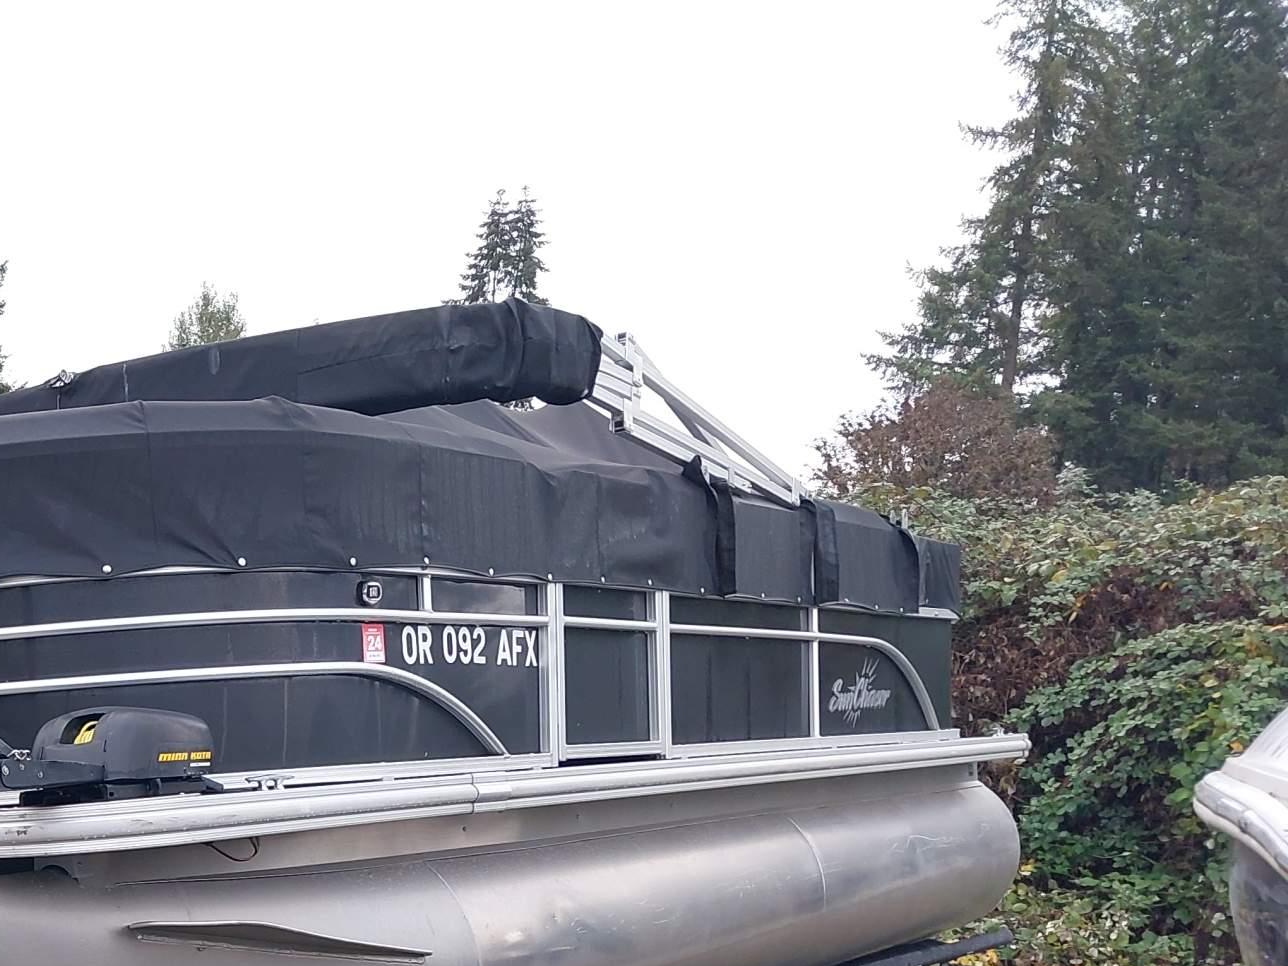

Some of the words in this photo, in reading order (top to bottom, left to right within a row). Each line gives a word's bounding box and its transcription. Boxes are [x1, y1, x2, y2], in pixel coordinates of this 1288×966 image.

[366, 635, 383, 652] 24
[401, 625, 434, 665] OR
[442, 625, 487, 664] 092
[496, 628, 538, 667] AFX
